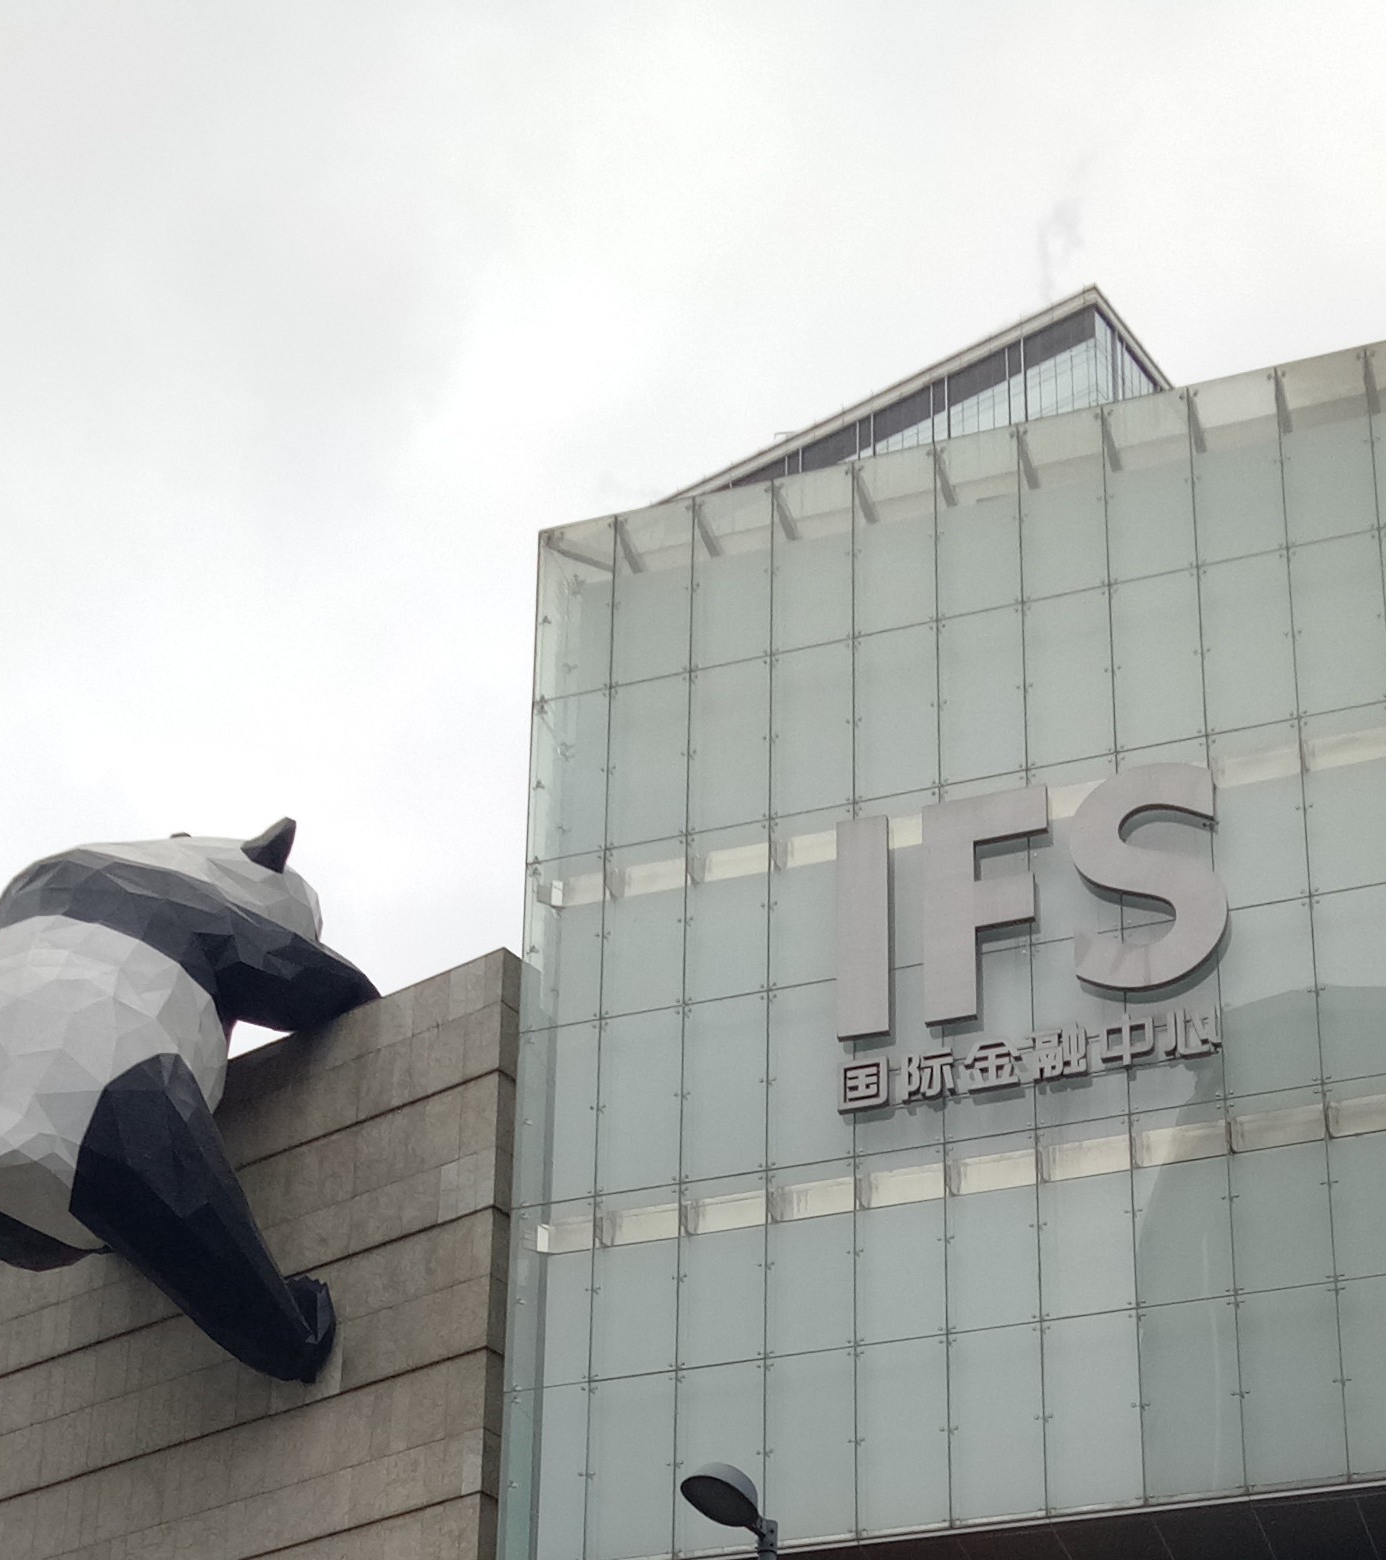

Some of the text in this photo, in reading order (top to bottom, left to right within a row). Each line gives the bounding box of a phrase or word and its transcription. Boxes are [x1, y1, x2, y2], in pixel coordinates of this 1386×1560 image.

[836, 762, 1231, 1042] IFS
[836, 1007, 1223, 1115] 国际金融中心
